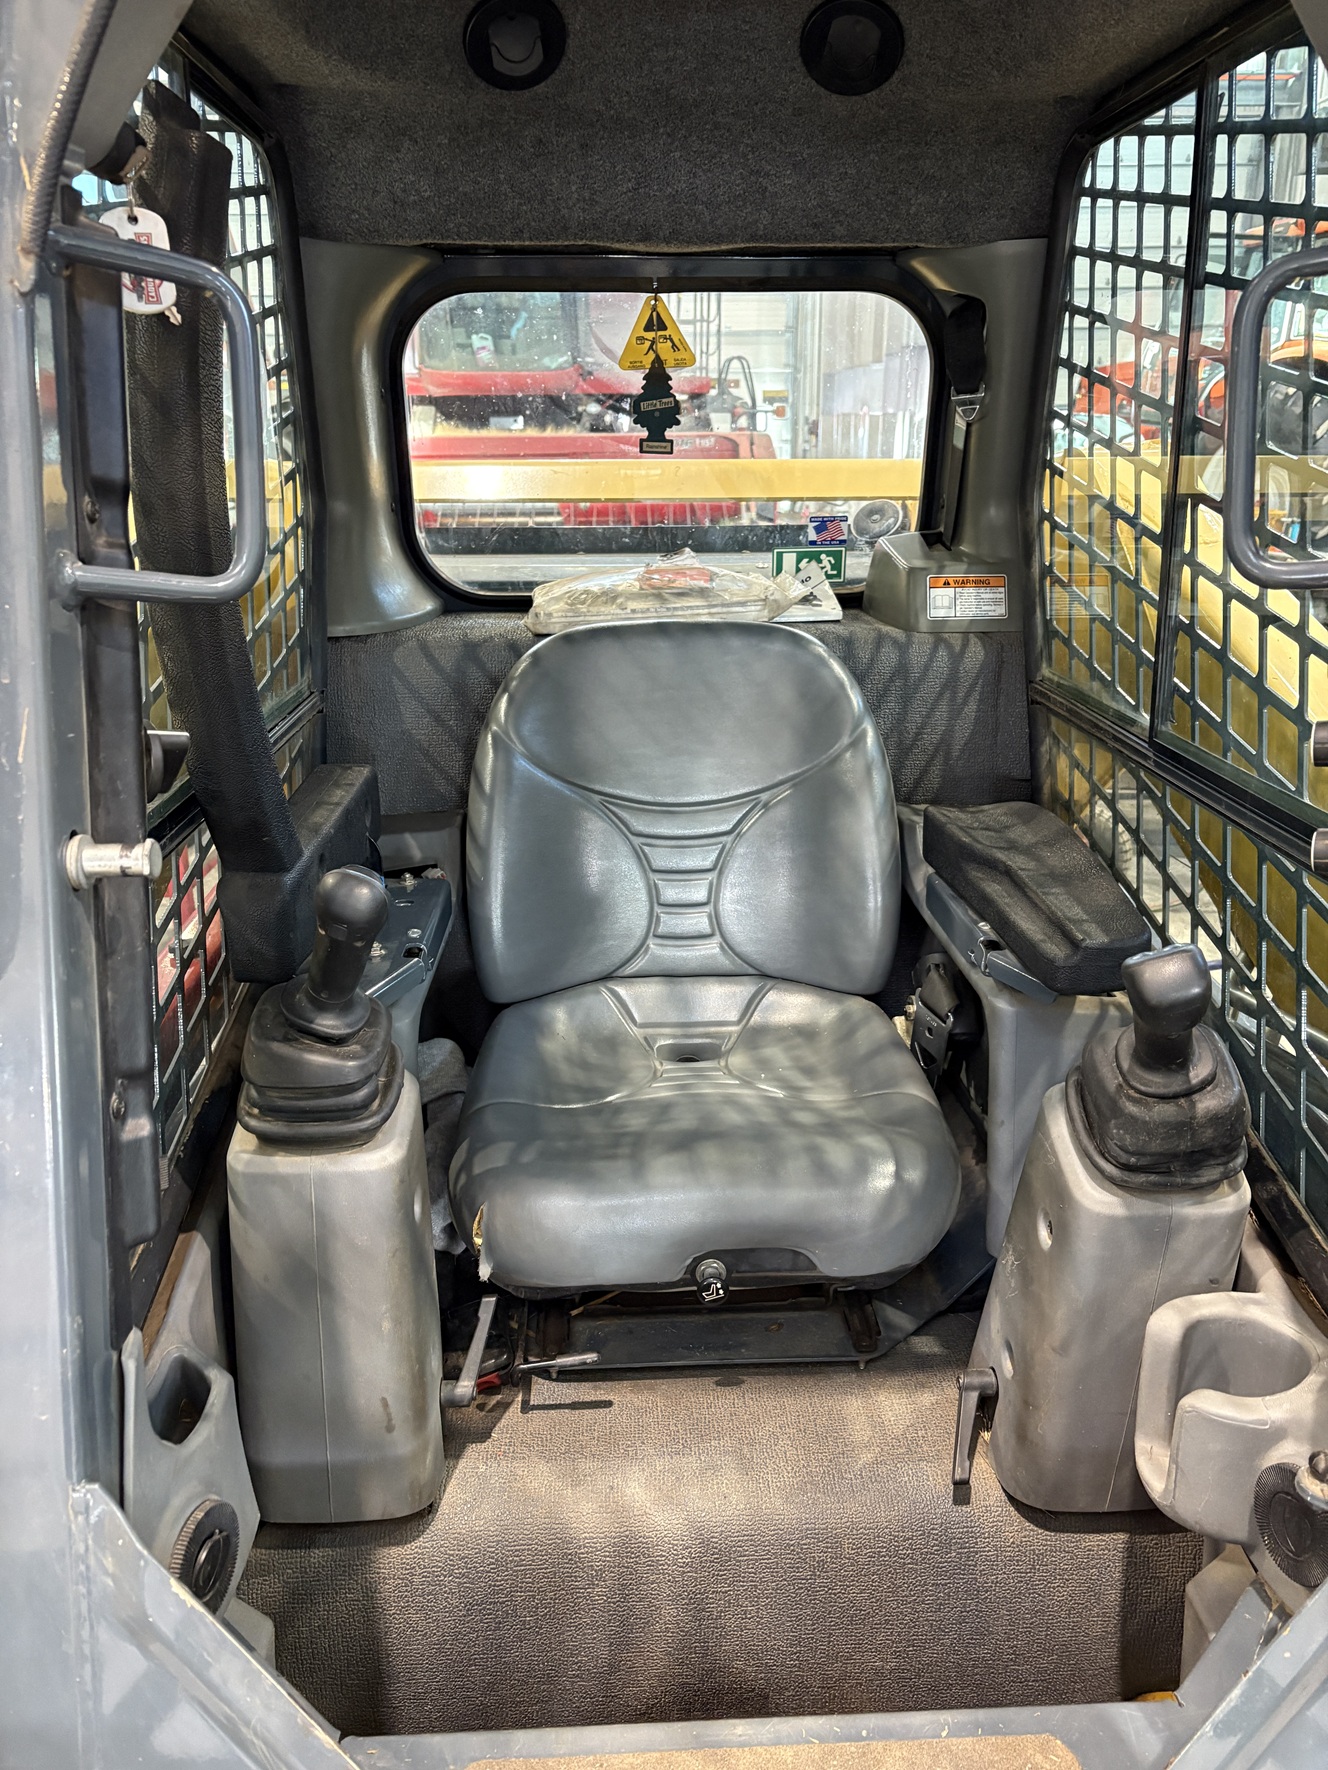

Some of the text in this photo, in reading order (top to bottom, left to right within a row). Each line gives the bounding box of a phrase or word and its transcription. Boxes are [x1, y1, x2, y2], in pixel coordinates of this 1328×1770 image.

[642, 399, 673, 410] Little Trees
[952, 578, 991, 586] WARNING
